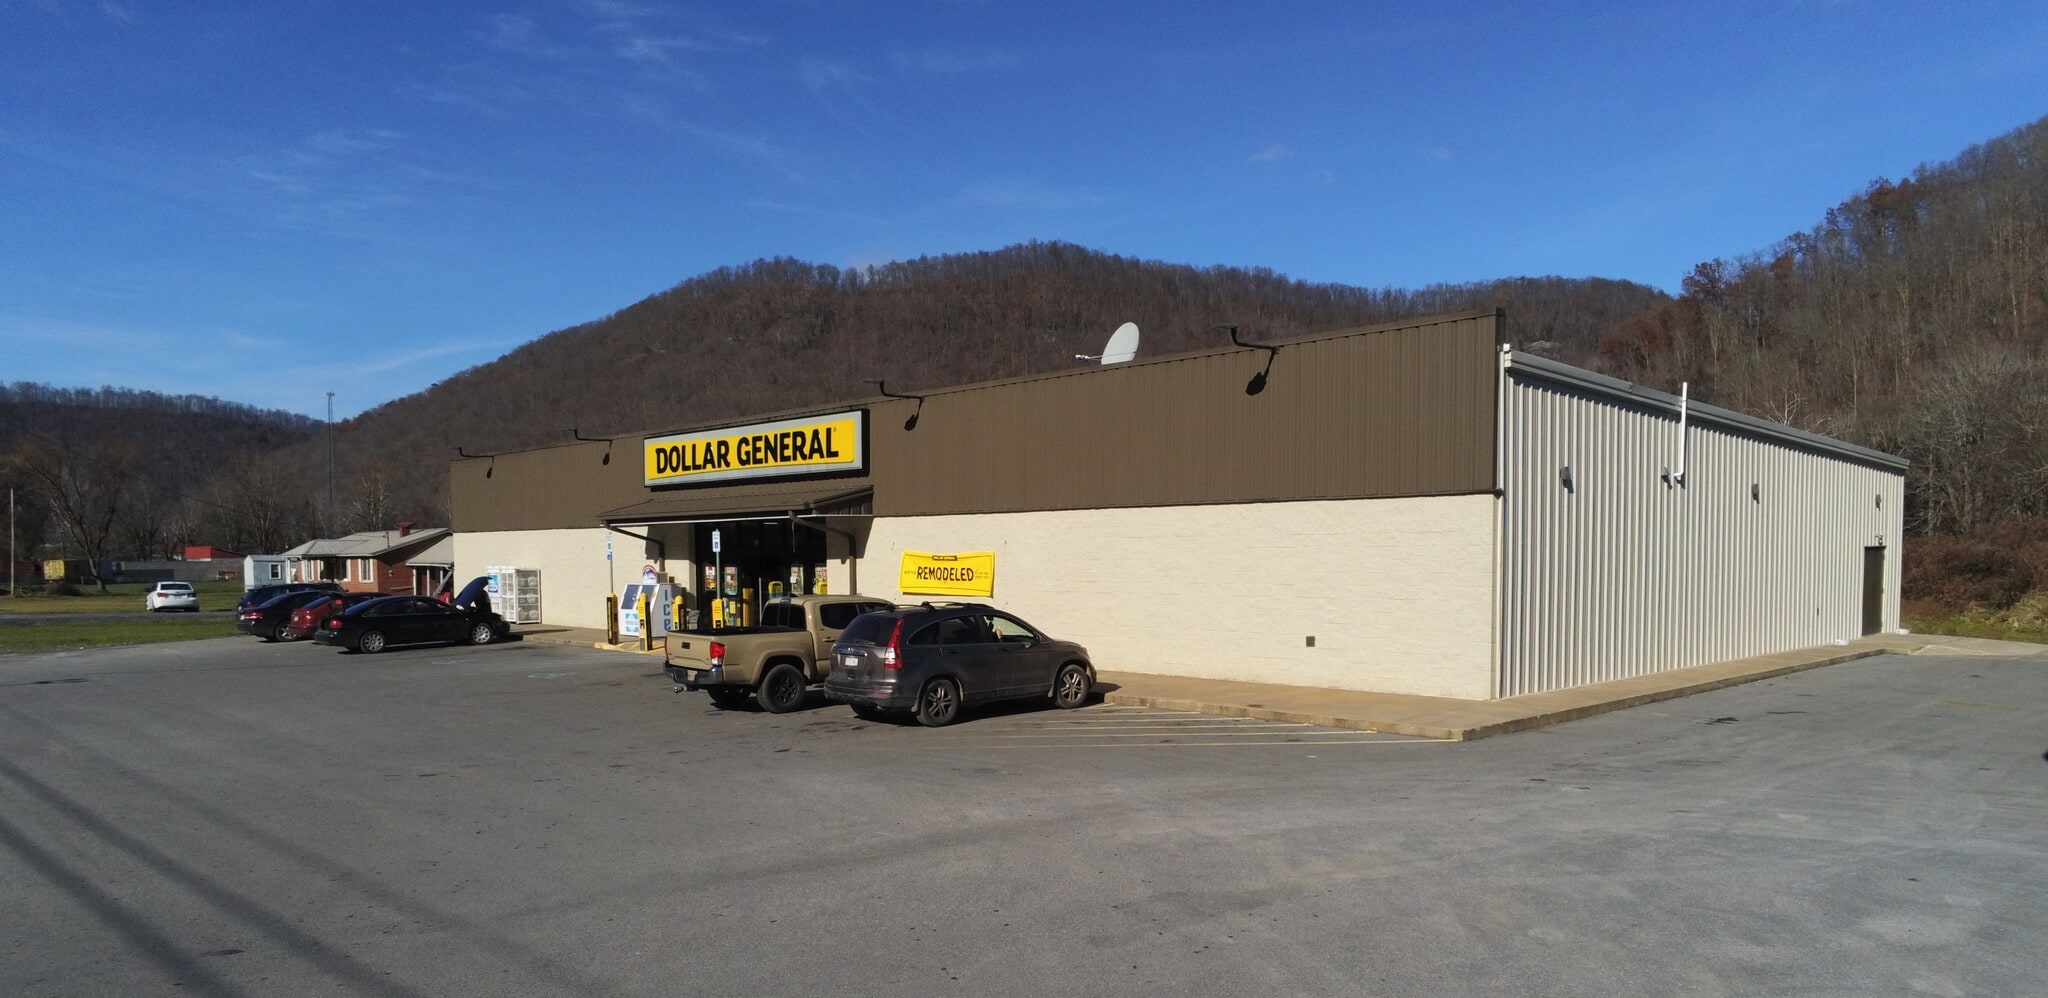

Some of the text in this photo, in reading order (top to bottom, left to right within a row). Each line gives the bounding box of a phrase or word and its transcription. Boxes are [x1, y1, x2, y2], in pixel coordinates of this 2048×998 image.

[655, 427, 839, 474] DOLLAR GENERAL
[916, 566, 974, 582] REMODELED
